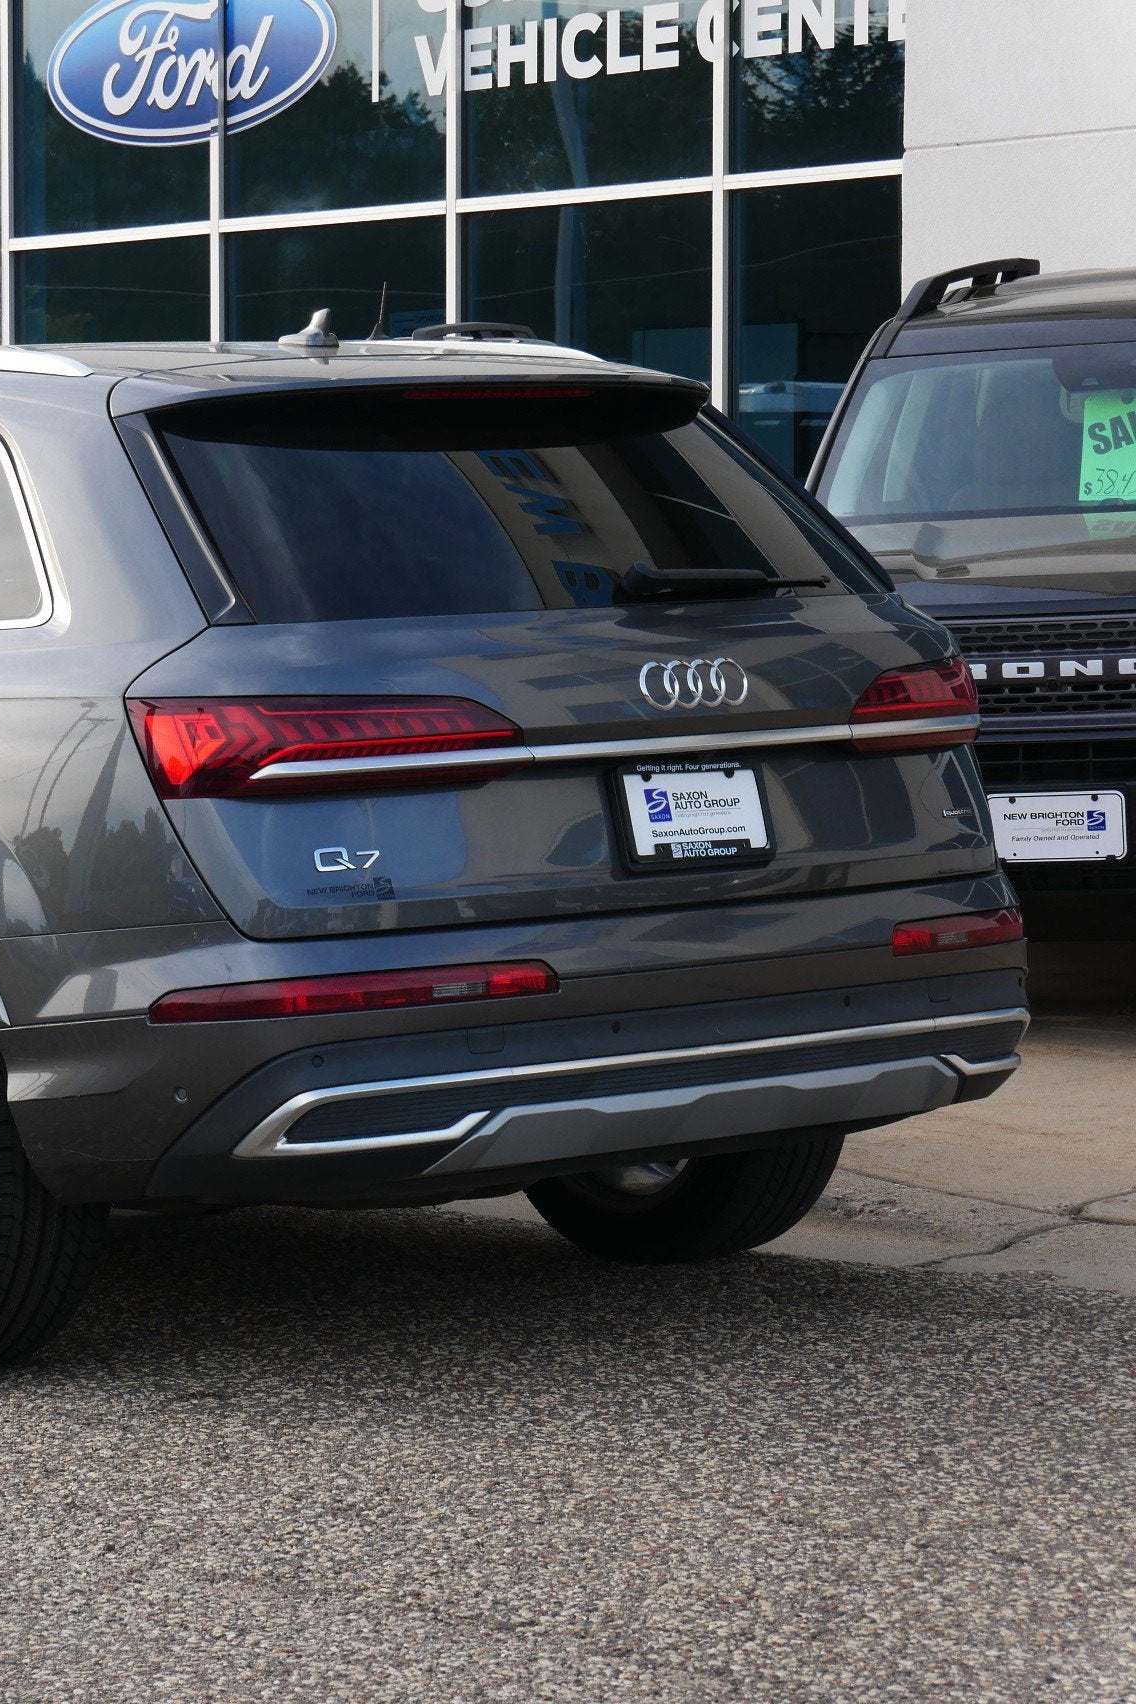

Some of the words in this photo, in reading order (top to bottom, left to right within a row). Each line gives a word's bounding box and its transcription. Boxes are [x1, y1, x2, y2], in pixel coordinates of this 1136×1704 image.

[414, 4, 680, 97] VEHICLE
[103, 2, 275, 116] Ford
[636, 764, 660, 773] Getting
[667, 763, 684, 773] right.
[685, 763, 700, 771] Four
[701, 761, 742, 771] generations.
[671, 791, 708, 801] SAXON
[675, 800, 702, 810] AUTO
[704, 797, 740, 809] GROUP
[1004, 813, 1028, 821] NEW
[1030, 811, 1084, 820] BRIGHTON
[651, 825, 746, 838] SaxonAutoGroup.com
[1033, 834, 1055, 842] Owned
[1071, 833, 1100, 841] Operated
[682, 841, 712, 850] SAXON
[684, 849, 706, 858] AUTO
[707, 847, 738, 857] GROUP
[313, 846, 380, 872] Q7
[306, 887, 328, 896] NEW
[329, 882, 375, 894] BRIGHTON
[351, 890, 376, 898] FORD
